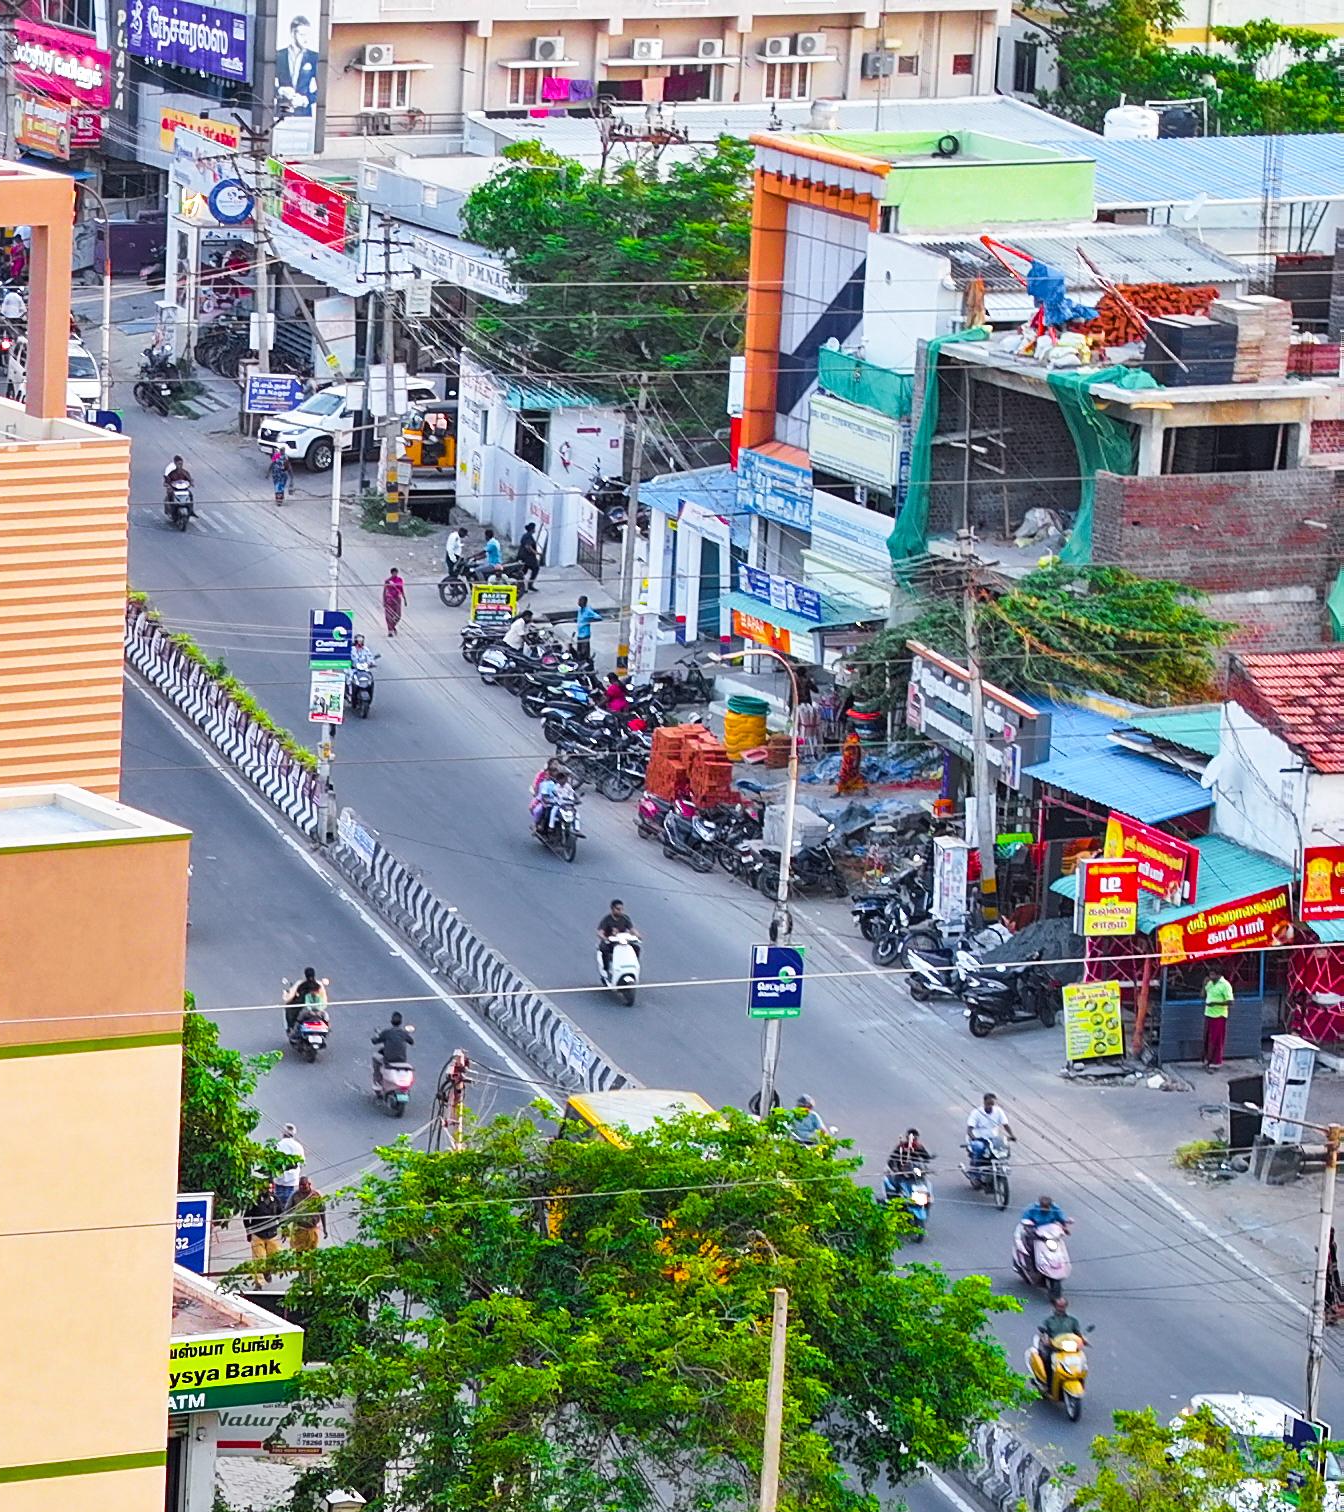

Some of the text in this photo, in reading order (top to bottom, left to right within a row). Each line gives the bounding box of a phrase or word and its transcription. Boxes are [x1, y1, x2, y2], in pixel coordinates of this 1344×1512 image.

[232, 1334, 284, 1354] பேங்க்
[169, 1359, 282, 1389] ysya Bank
[168, 1392, 205, 1410] ATM
